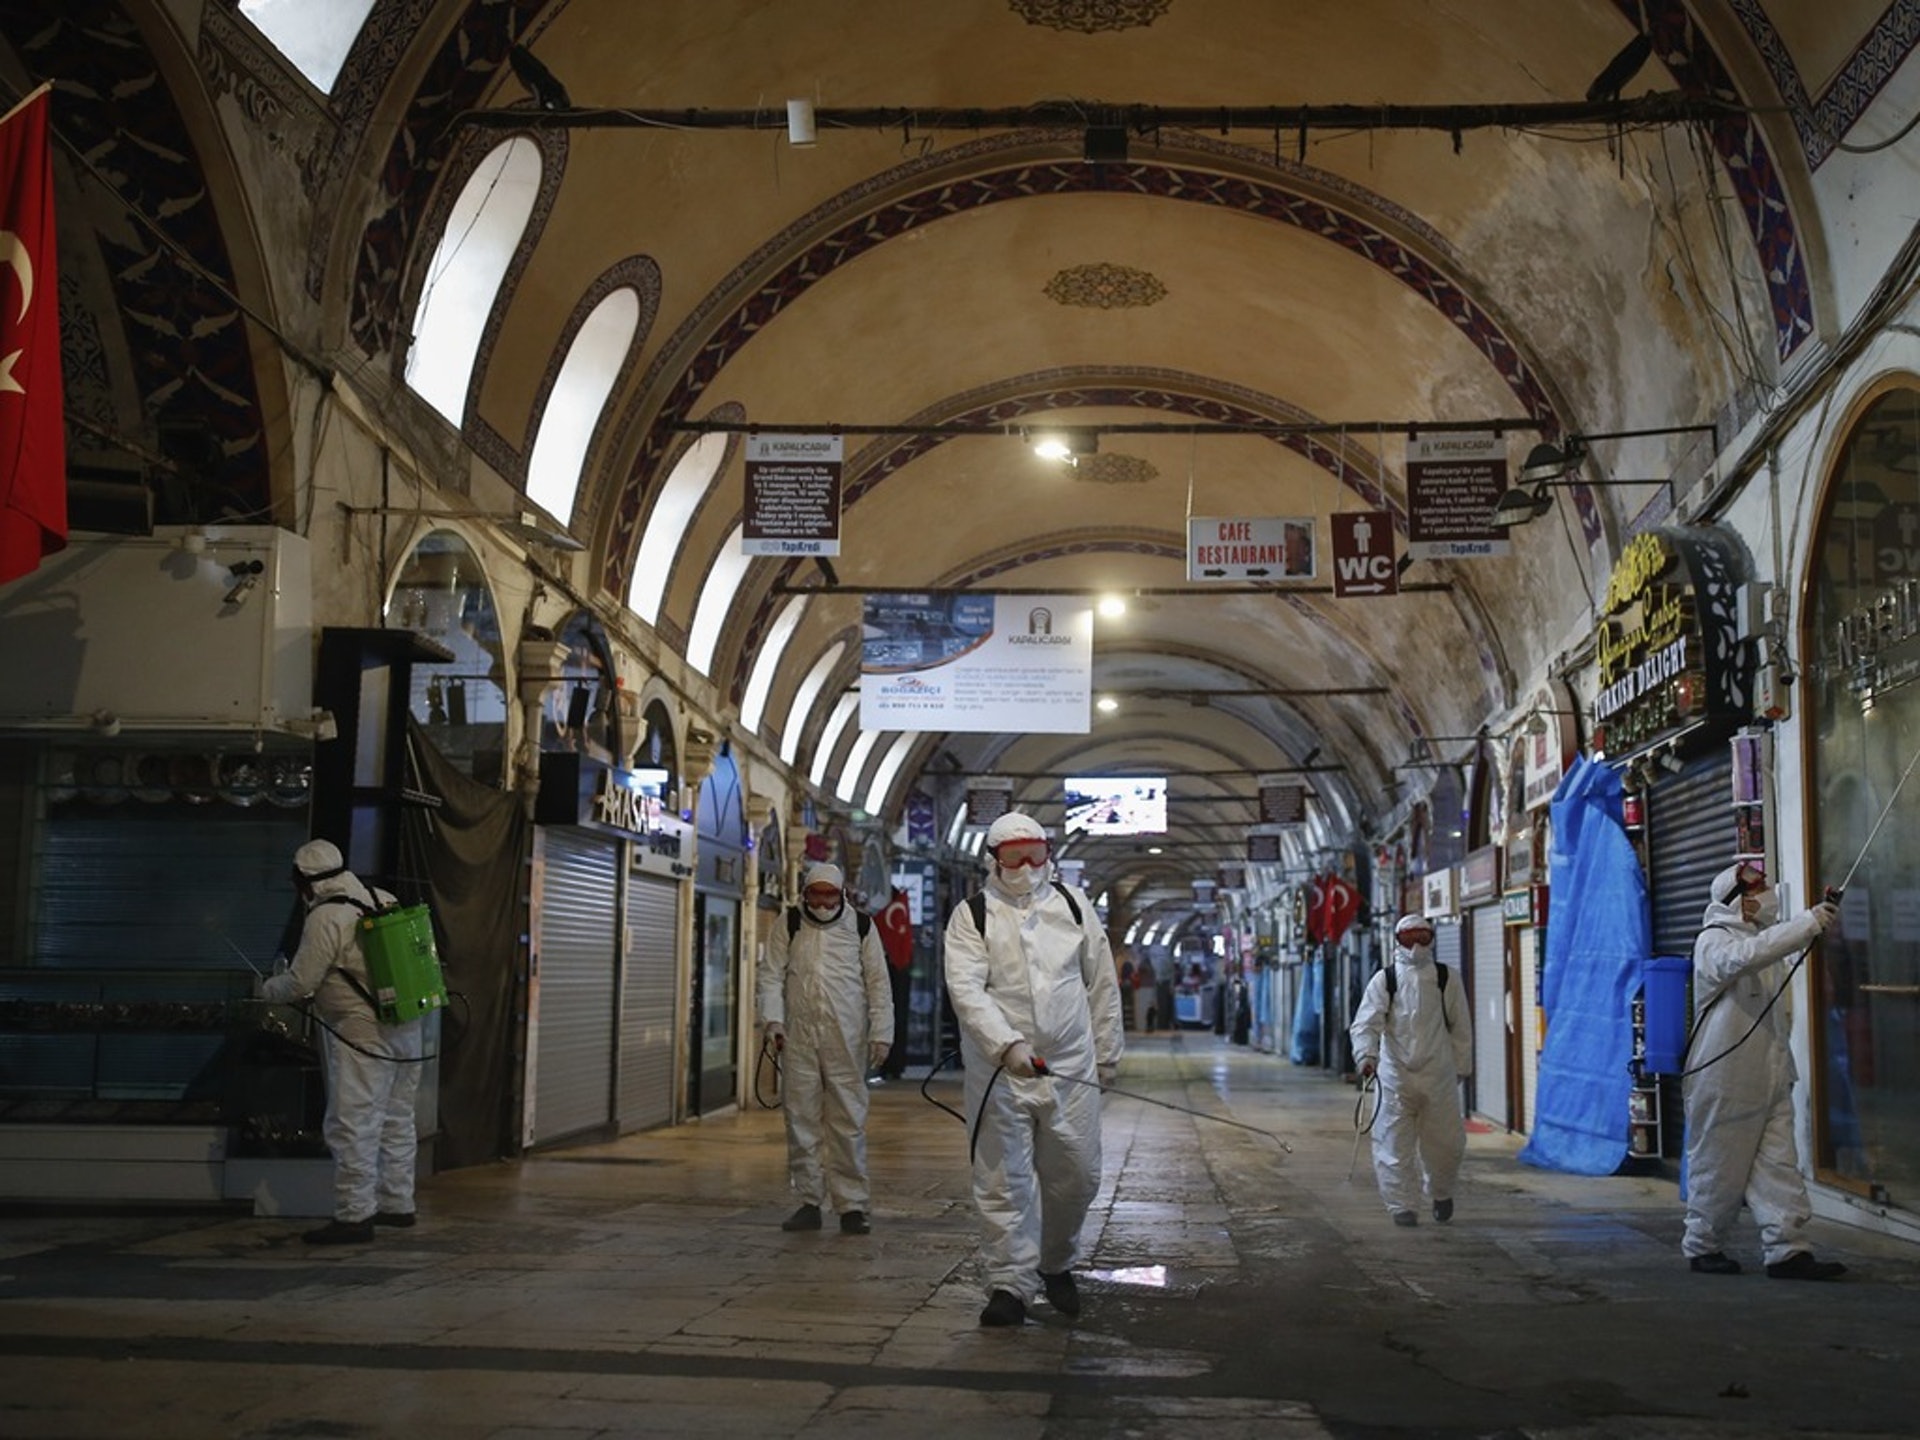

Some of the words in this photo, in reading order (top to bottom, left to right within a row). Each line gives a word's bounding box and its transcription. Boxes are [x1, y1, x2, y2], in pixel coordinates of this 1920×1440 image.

[1218, 523, 1252, 541] CAFE
[1198, 546, 1286, 565] RESTAURANT
[1337, 555, 1393, 581] WC
[1594, 671, 1635, 723] TURKISH
[1637, 635, 1687, 697] DELIGHT
